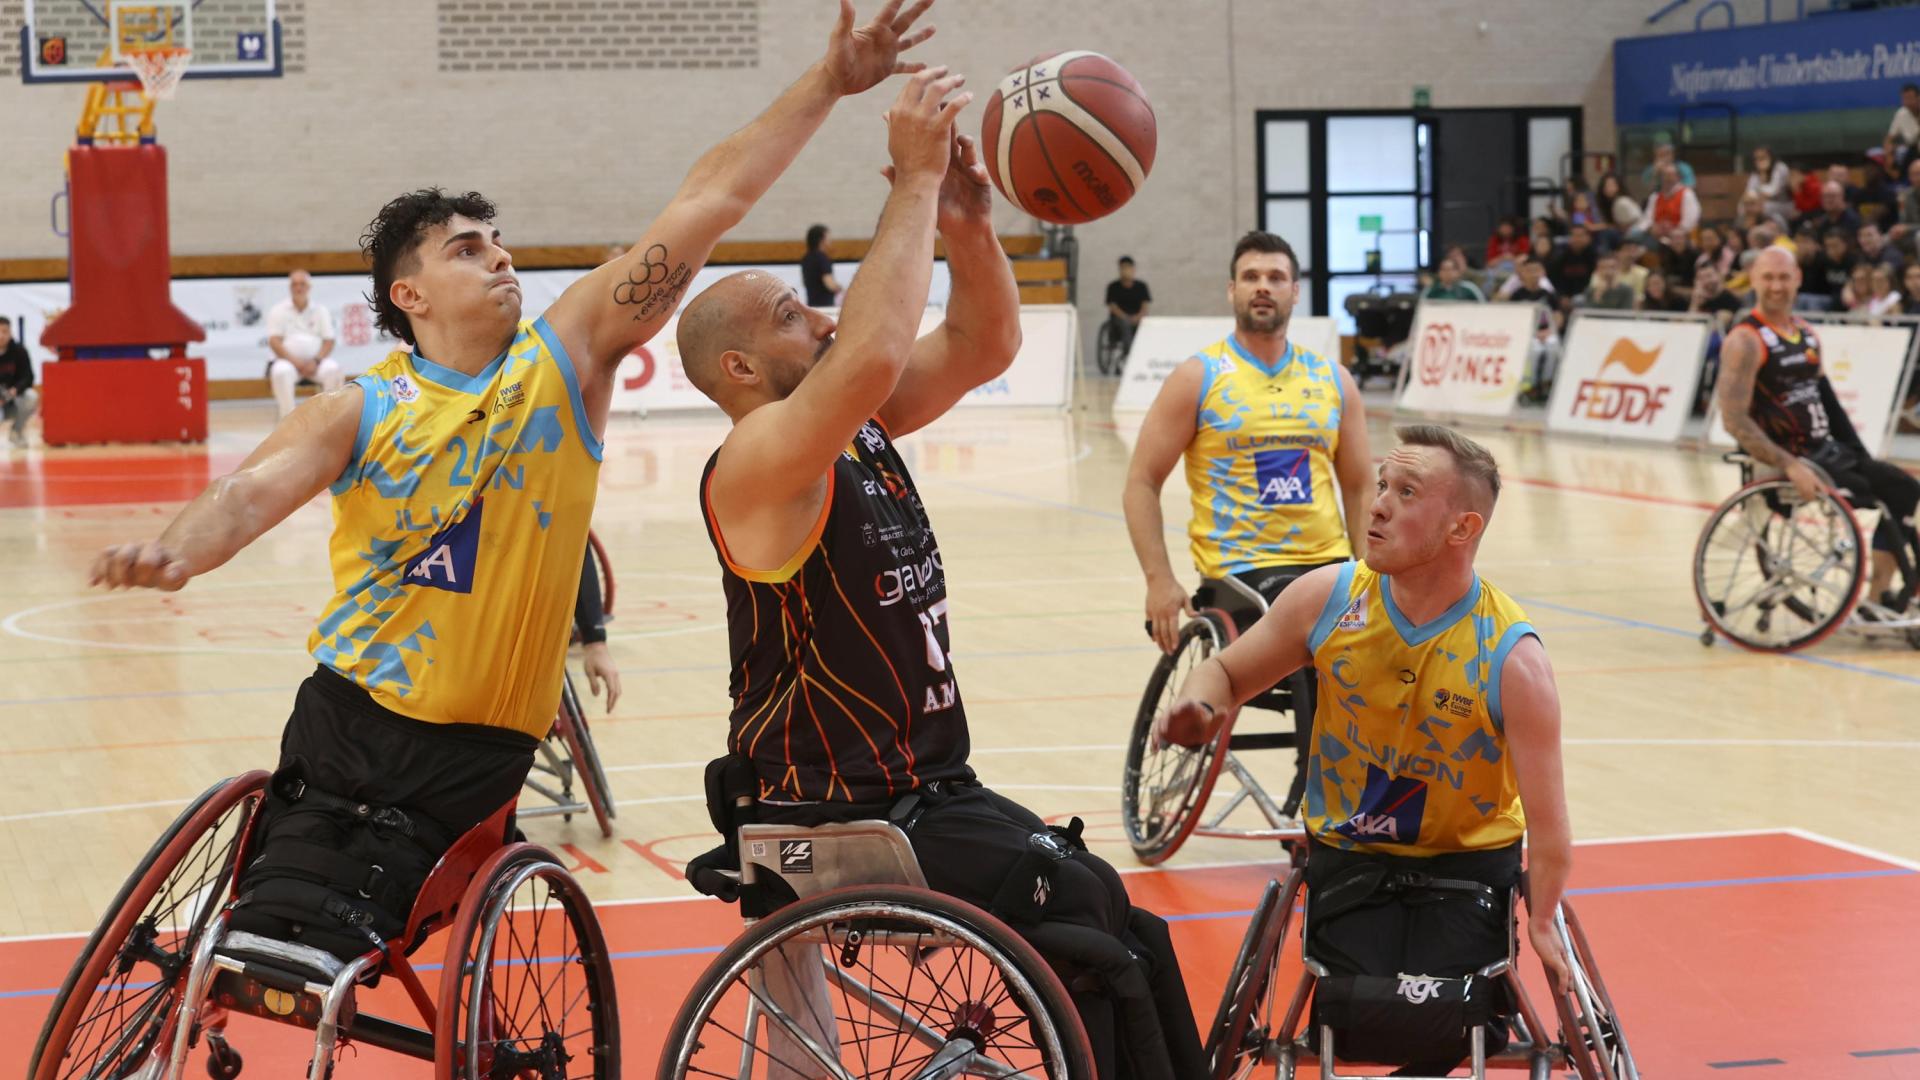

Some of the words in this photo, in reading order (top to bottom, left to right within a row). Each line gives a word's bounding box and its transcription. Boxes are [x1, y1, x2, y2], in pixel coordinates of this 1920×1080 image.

[500, 381, 523, 397] IWBF
[1271, 402, 1294, 419] 12
[1570, 378, 1671, 426] FEDDF
[1227, 435, 1332, 450] ILUNION
[1259, 476, 1306, 501] AXA
